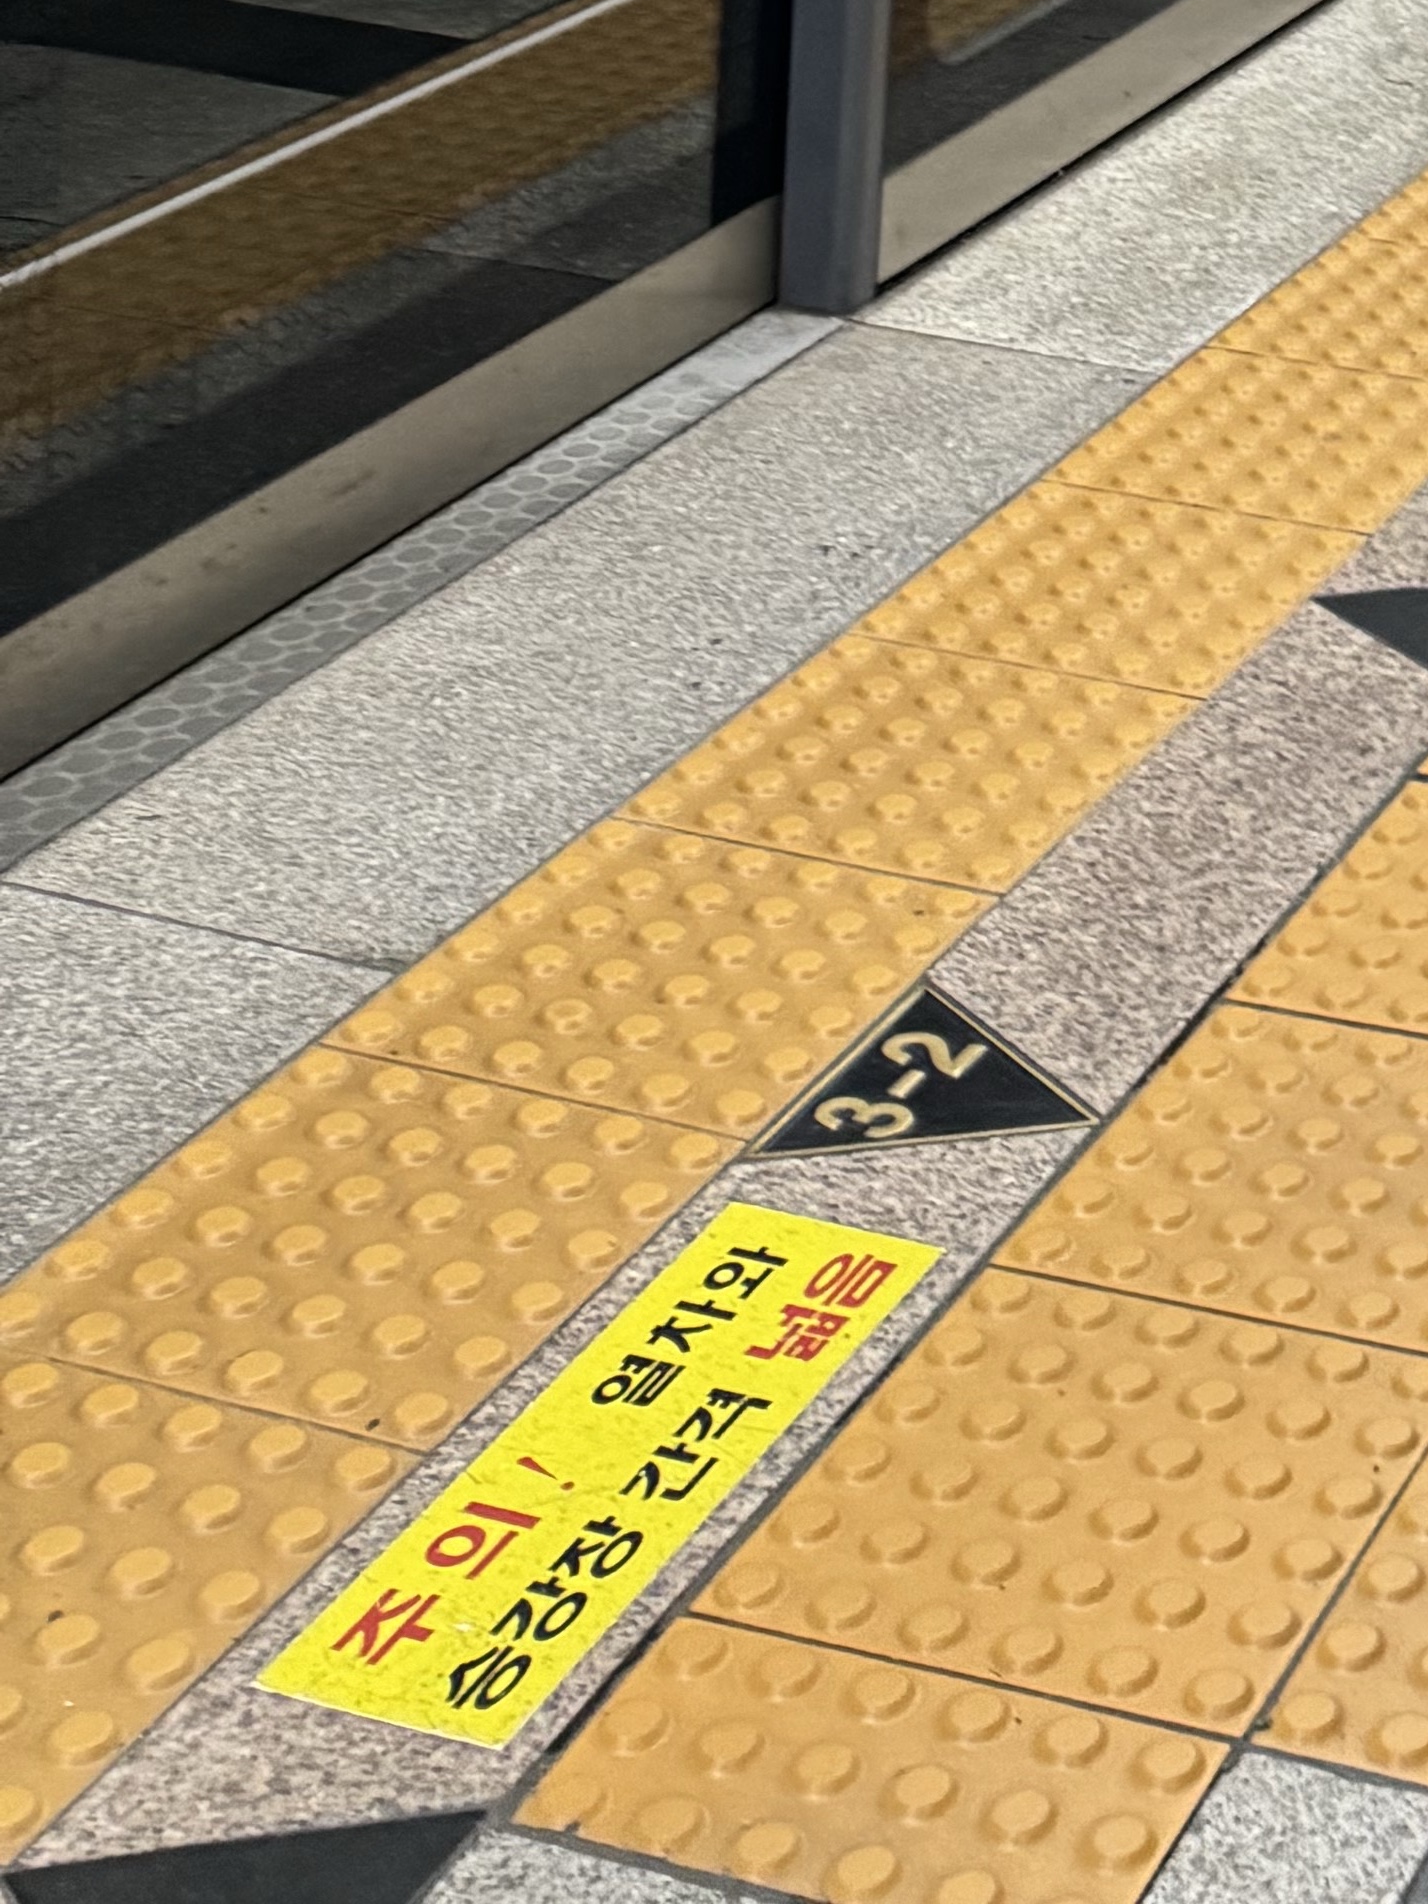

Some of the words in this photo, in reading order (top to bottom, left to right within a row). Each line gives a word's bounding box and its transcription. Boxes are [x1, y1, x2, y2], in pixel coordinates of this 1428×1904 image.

[815, 1029, 988, 1141] 3-2
[590, 1244, 790, 1409] 열차와
[446, 1513, 646, 1711] 승강장
[621, 1385, 774, 1503] 간격
[745, 1251, 898, 1364] 넓음
